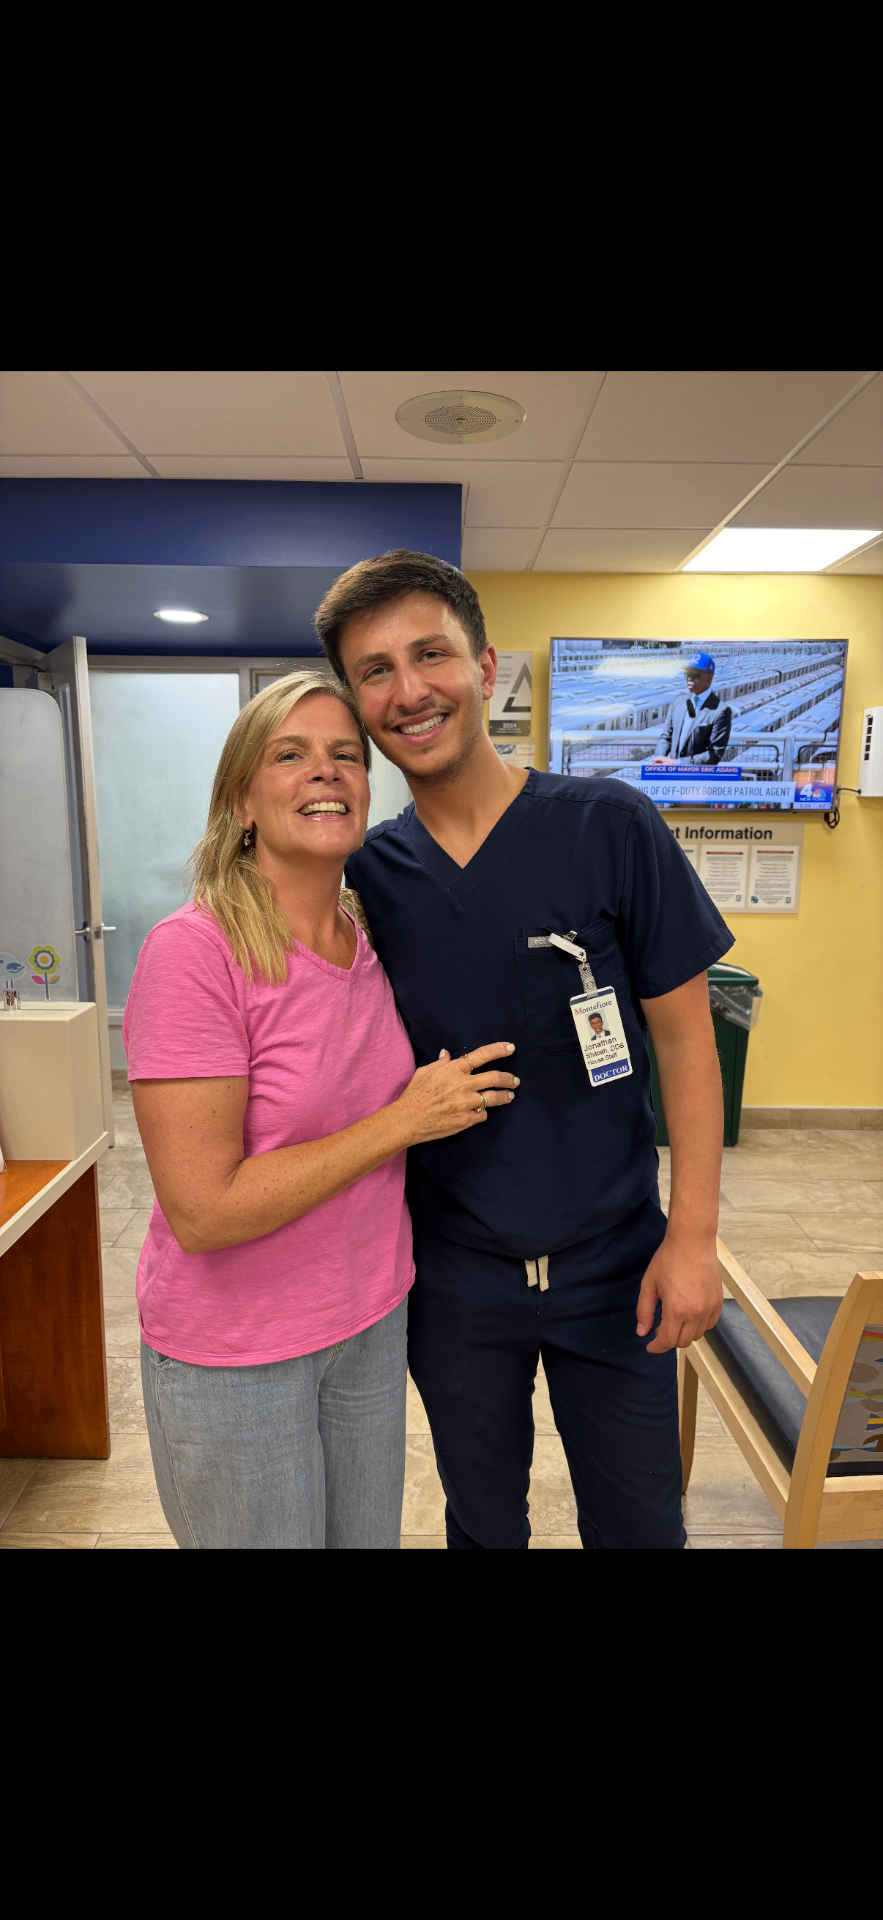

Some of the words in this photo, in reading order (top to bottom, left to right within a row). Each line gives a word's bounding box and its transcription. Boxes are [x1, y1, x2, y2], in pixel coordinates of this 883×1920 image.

[650, 786, 660, 796] OF
[661, 786, 700, 796] OFF-DUTY
[702, 786, 732, 796] BORDER
[733, 786, 763, 796] PATROL
[765, 786, 792, 797] AGENT
[799, 783, 813, 798] 4
[685, 825, 773, 840] Information
[574, 1000, 613, 1016] Montefiore
[584, 1037, 617, 1052] Jonathan
[587, 1057, 604, 1066] House
[605, 1052, 618, 1061] Staff
[594, 1065, 628, 1082] DOCTOR
